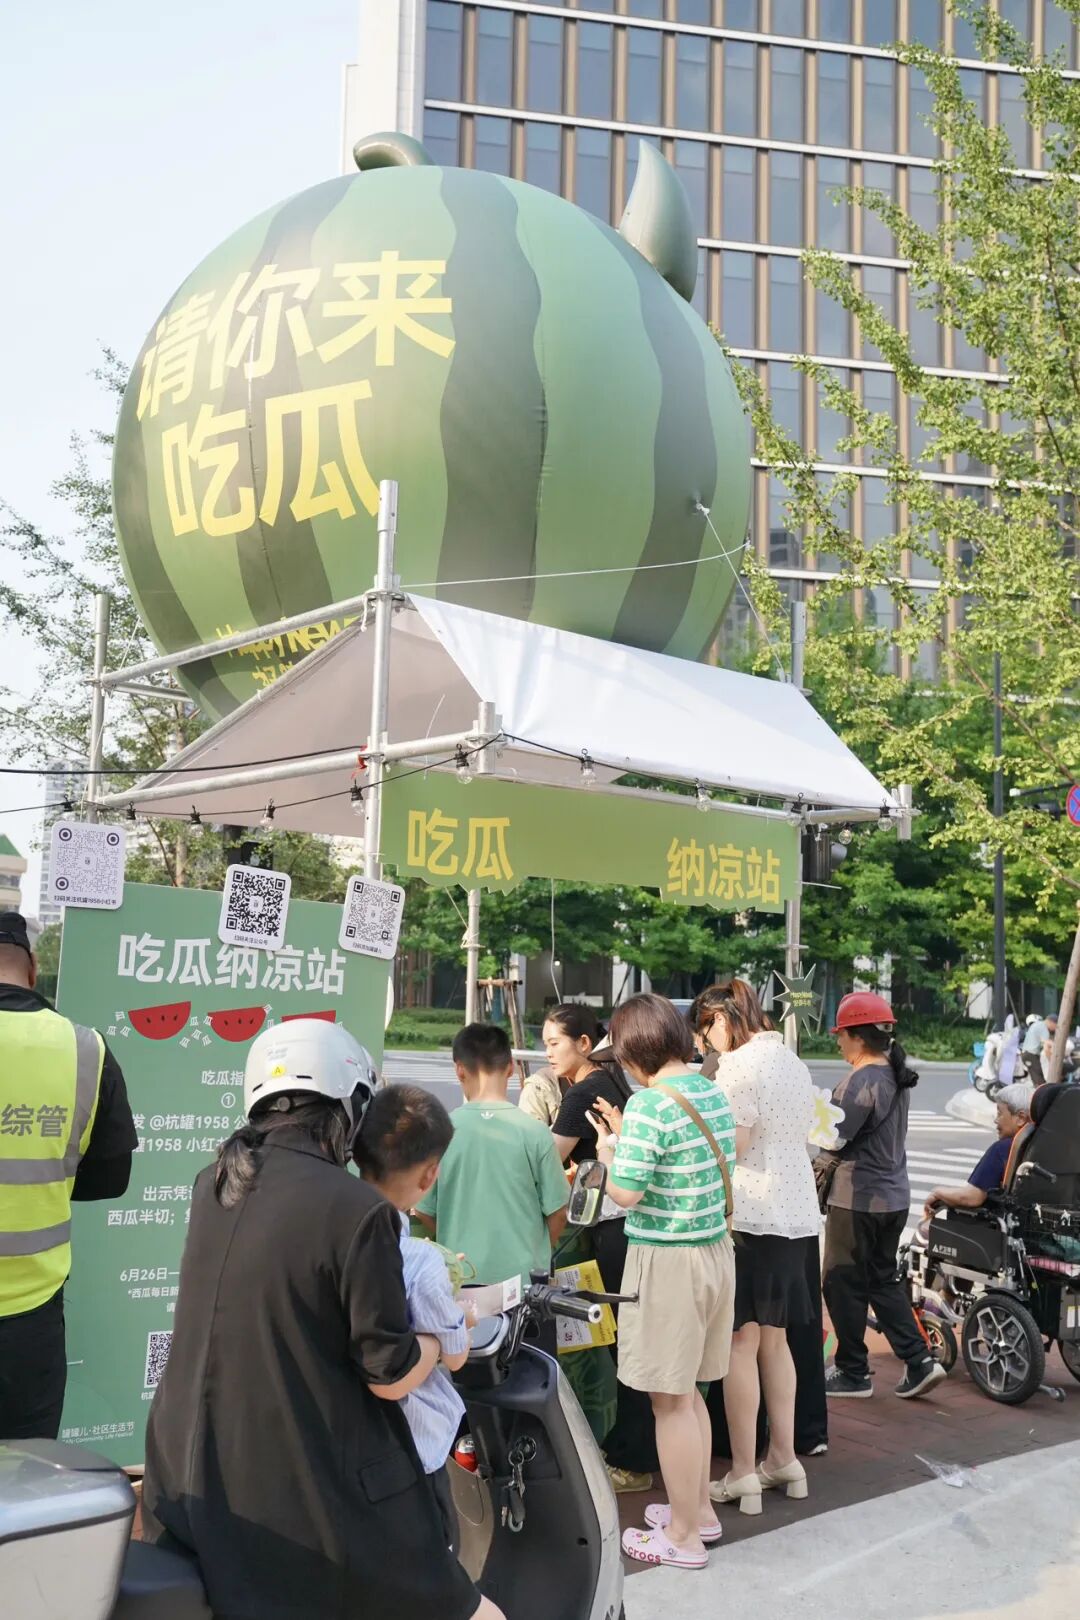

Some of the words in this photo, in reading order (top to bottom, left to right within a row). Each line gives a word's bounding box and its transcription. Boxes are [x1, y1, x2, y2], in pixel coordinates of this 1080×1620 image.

[136, 250, 456, 422] 请你来
[162, 379, 380, 537] 吃瓜
[407, 808, 514, 880] 吃瓜
[666, 837, 781, 904] 纳凉站
[117, 933, 347, 995] 吃瓜纳凉站
[1, 1104, 68, 1137] 综管
[149, 1114, 230, 1131] @杭罐1958
[627, 1546, 662, 1564] crocs
